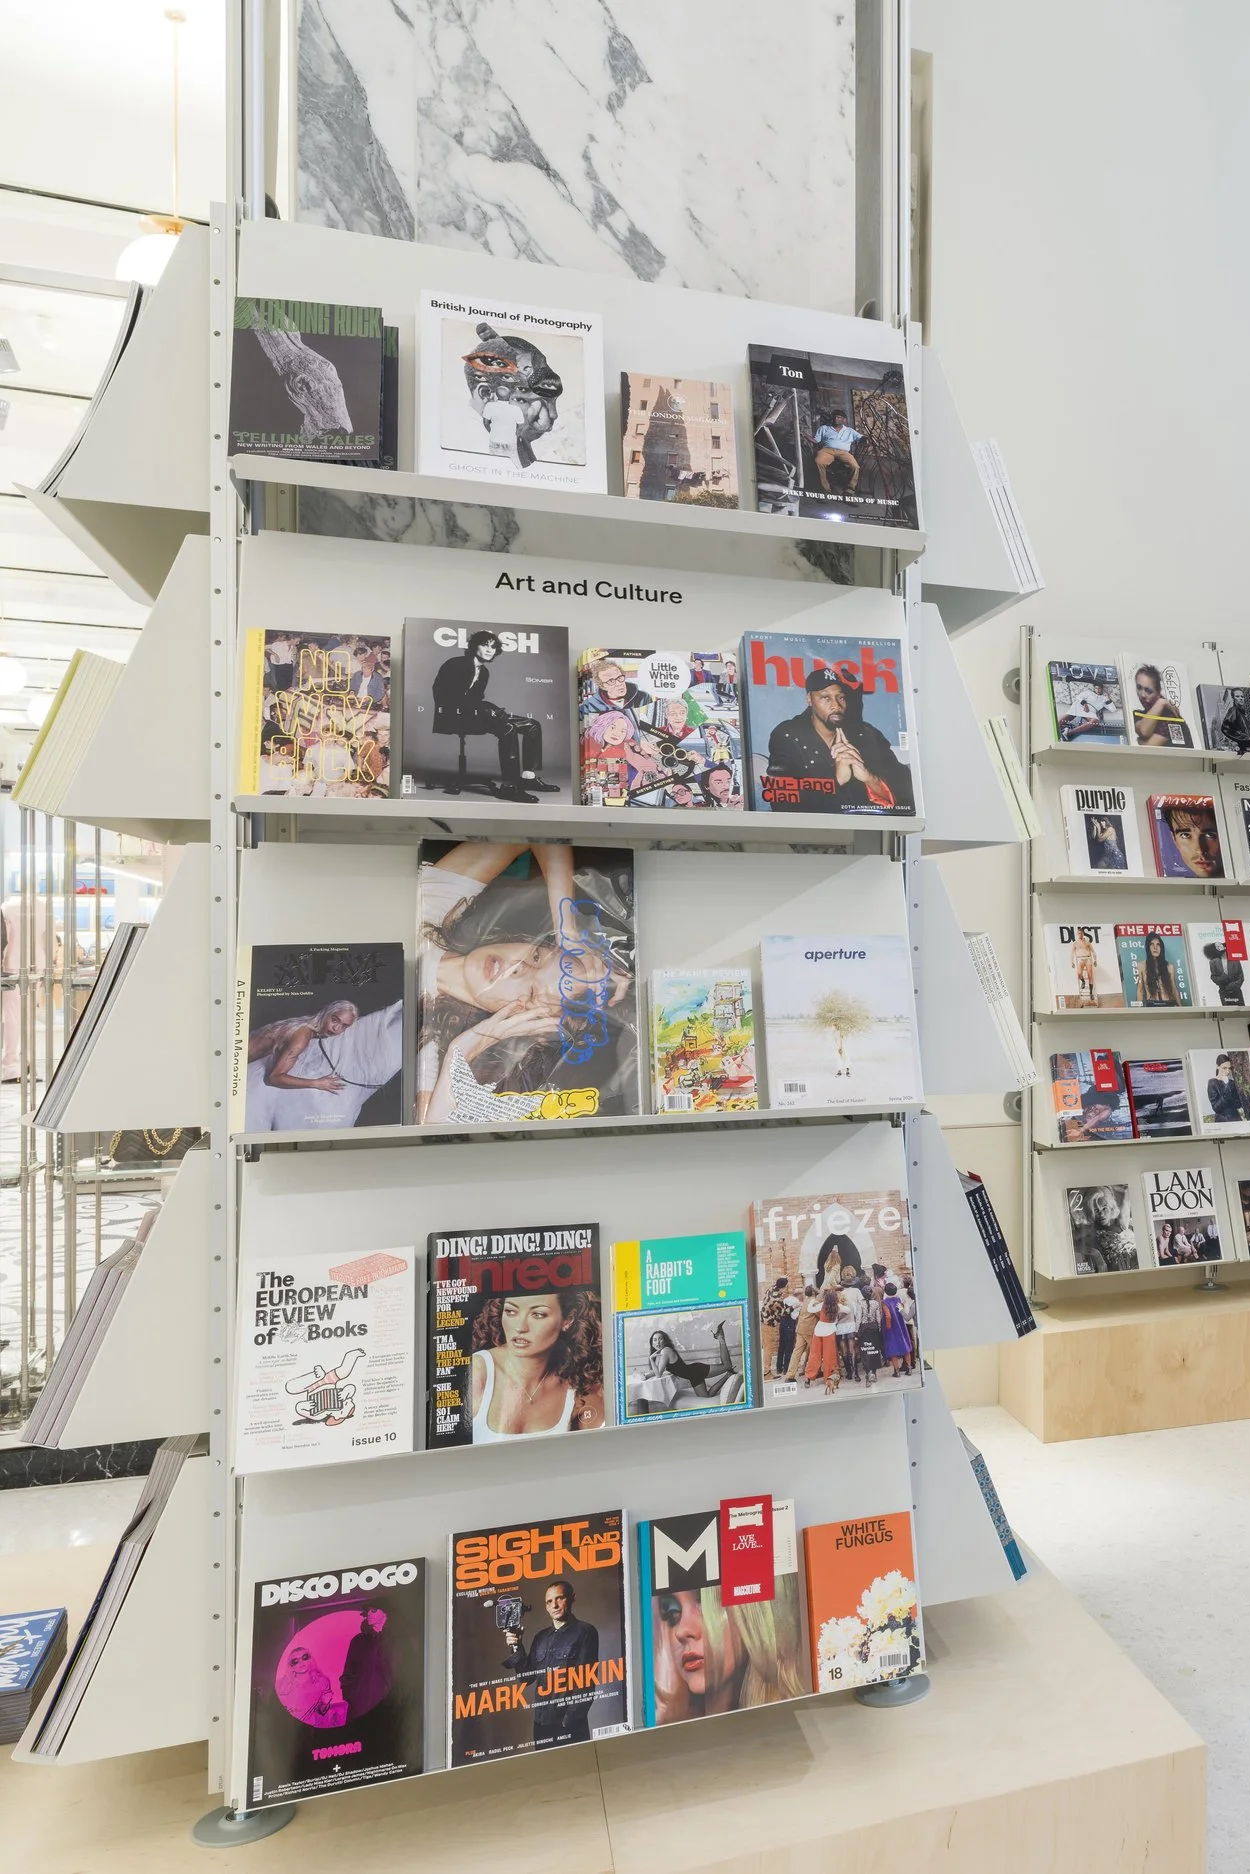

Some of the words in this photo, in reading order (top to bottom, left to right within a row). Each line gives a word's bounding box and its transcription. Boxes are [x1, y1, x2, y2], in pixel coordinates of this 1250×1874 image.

[431, 300, 465, 313] British
[468, 306, 506, 319] Journal
[524, 315, 592, 332] Photography
[779, 365, 804, 380] Ton
[233, 431, 313, 444] TELLING
[320, 433, 375, 445] TALES
[449, 464, 488, 474] GHOST
[505, 470, 527, 479] THE
[530, 473, 580, 484] MACHINE
[782, 488, 804, 498] MAKE
[805, 491, 825, 500] YOUR
[876, 498, 900, 506] MUSIC
[495, 572, 535, 592] Art
[542, 580, 588, 596] and
[595, 581, 682, 604] Culture
[433, 627, 540, 654] CLSH
[300, 649, 350, 693] NO
[649, 670, 680, 680] White
[650, 662, 678, 673] Little
[1055, 663, 1118, 681] LOVE
[654, 680, 676, 689] Lies
[275, 690, 373, 738] WAY
[270, 735, 375, 782] BACK
[761, 775, 835, 793] Wu-Tang
[762, 790, 800, 803] Clan
[1075, 788, 1126, 812] purple
[1059, 926, 1101, 944] DUST
[1119, 925, 1144, 934] THE
[1148, 925, 1180, 934] FACE
[804, 949, 866, 962] aperture
[1154, 1170, 1205, 1192] LAM
[1069, 1190, 1083, 1211] 72
[1150, 1189, 1214, 1212] POON
[763, 1204, 901, 1242] frieze
[436, 1236, 487, 1258] DING!
[491, 1233, 540, 1255] DING!
[544, 1230, 592, 1251] DING!
[646, 1250, 652, 1262] A
[436, 1248, 592, 1293] Unreal
[646, 1260, 693, 1280] RABBIT'S
[256, 1272, 295, 1289] The
[451, 1279, 467, 1287] GOT
[646, 1279, 672, 1296] FOOT
[256, 1284, 369, 1308] EUROPEAN
[436, 1286, 478, 1296] NEWFOUND
[436, 1294, 469, 1304] RESPECT
[255, 1304, 336, 1327] REVIEW
[437, 1304, 451, 1312] FOR
[437, 1311, 461, 1319] URBAN
[254, 1328, 279, 1346] of
[307, 1321, 368, 1341] Books
[352, 1435, 382, 1446] issue
[385, 1432, 397, 1442] 10
[841, 1520, 886, 1536] WHITE
[456, 1521, 589, 1564] SIGHT
[580, 1531, 621, 1546] AND
[739, 1534, 754, 1542] WE
[836, 1531, 893, 1550] FUNGUS
[654, 1516, 720, 1590] M
[456, 1541, 621, 1590] SOUND
[261, 1574, 339, 1608] DISCO
[341, 1562, 418, 1595] POGO
[828, 1667, 842, 1680] 18
[455, 1682, 528, 1720] MARK
[537, 1656, 624, 1698] JENKIN
[312, 1741, 362, 1761] TOMORA
